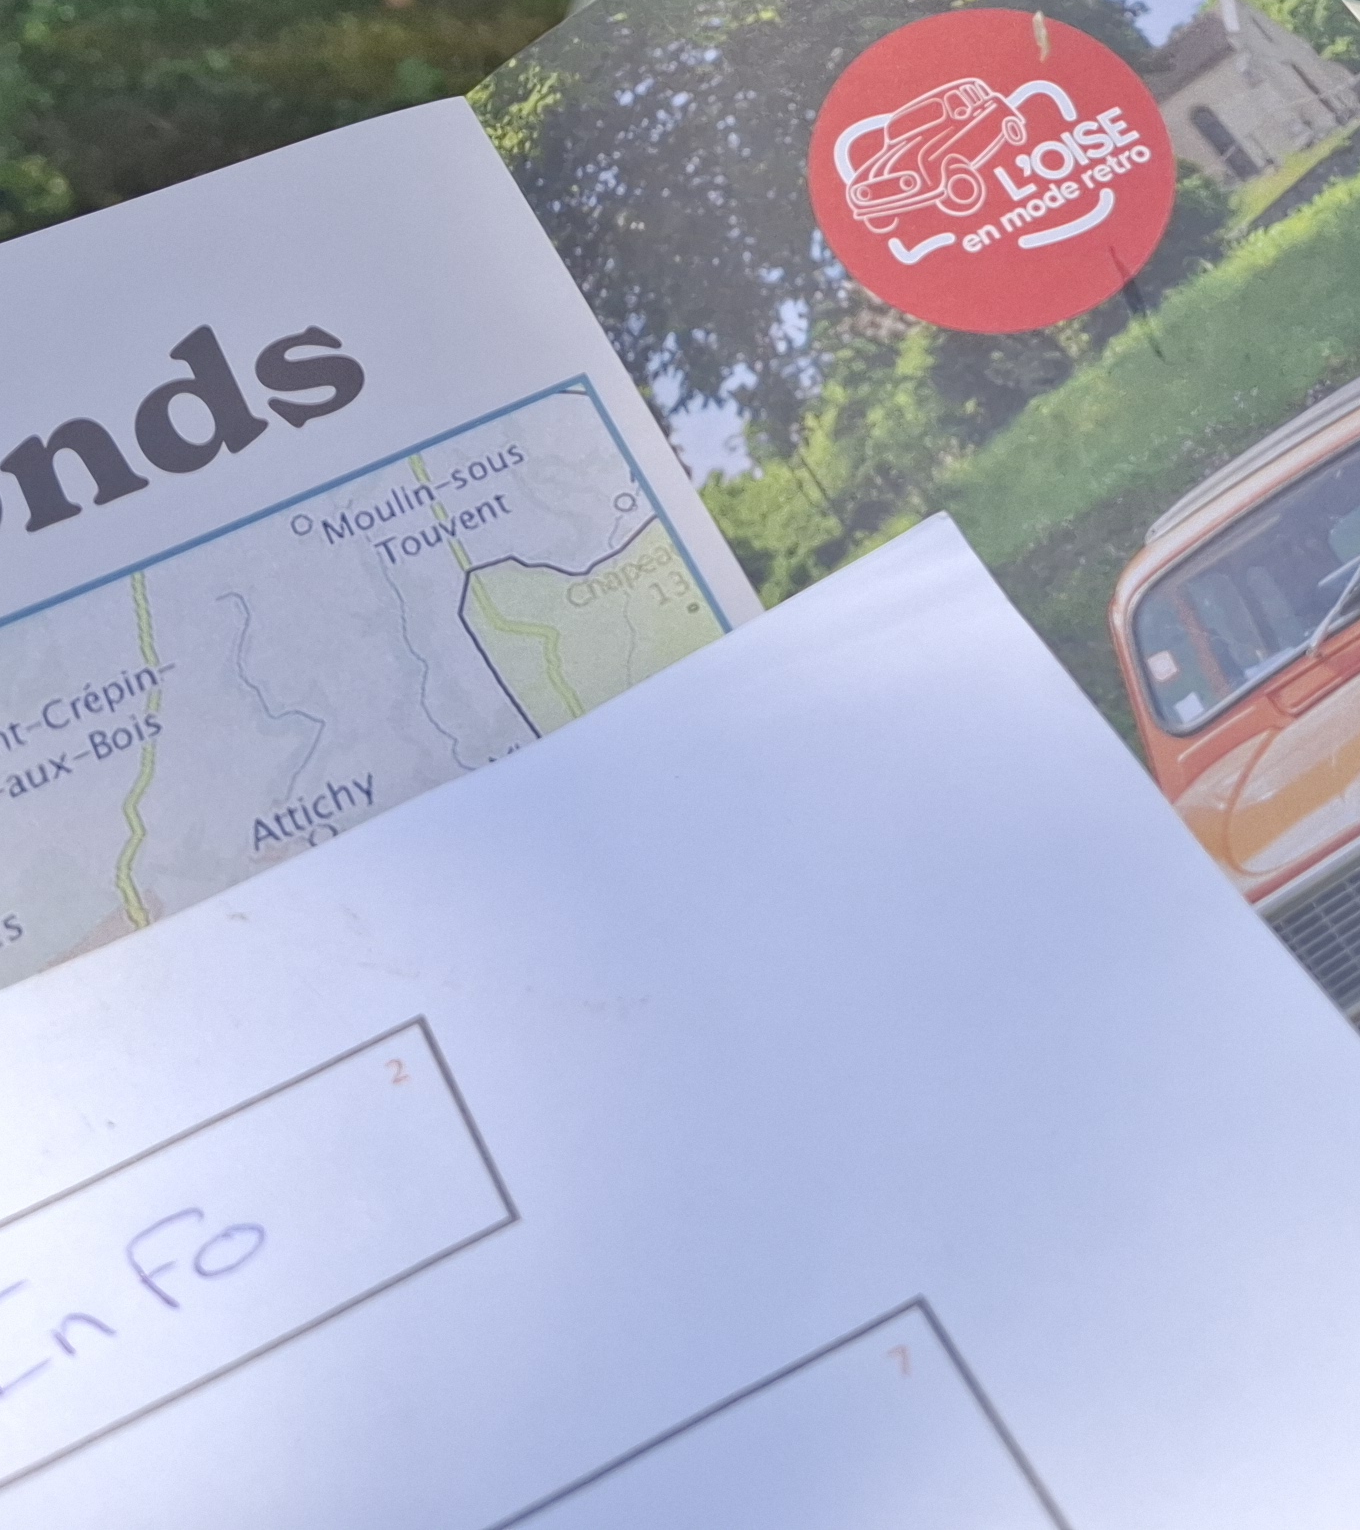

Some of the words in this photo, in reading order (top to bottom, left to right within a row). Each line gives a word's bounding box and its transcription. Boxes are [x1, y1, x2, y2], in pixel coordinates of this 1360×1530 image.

[961, 224, 1002, 253] en
[999, 180, 1081, 233] mode
[1080, 145, 1152, 189] retro
[322, 442, 526, 546] Moulin-sous
[375, 491, 513, 566] Touvent
[251, 772, 375, 851] Attichy
[384, 1058, 410, 1085] 2
